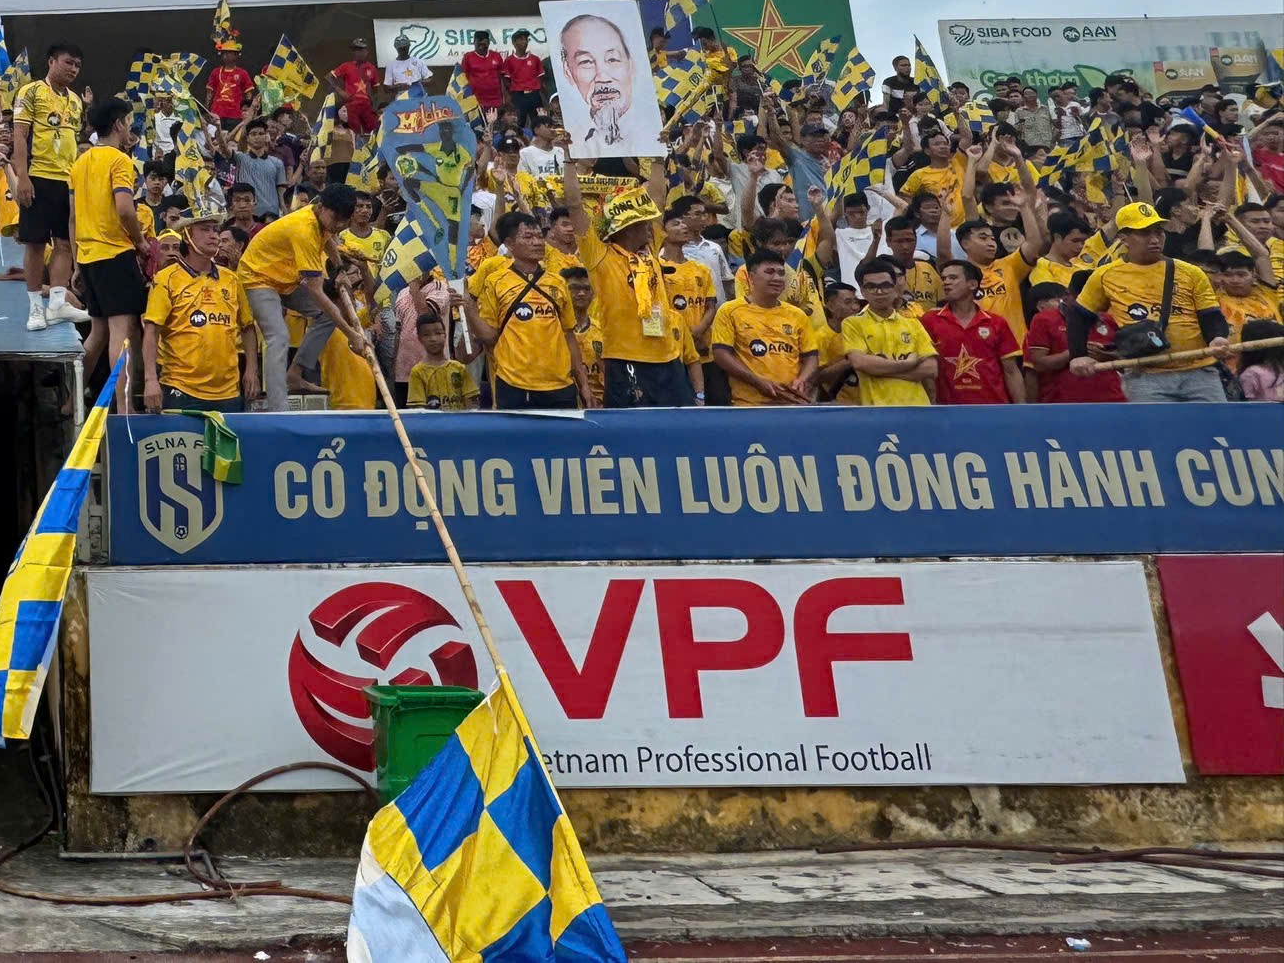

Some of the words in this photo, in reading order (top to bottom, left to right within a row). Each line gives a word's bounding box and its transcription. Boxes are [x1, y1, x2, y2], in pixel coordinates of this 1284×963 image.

[976, 27, 1009, 38] SIBA
[1012, 27, 1052, 38] FOOD
[1082, 25, 1117, 38] AAN
[144, 437, 187, 455] SLNA
[193, 439, 205, 449] F
[273, 437, 346, 519] CỔ
[363, 446, 517, 530] ĐỘNG
[531, 445, 662, 515] VIÊN
[676, 443, 824, 514] LUÔN
[837, 433, 995, 512] ĐỒNG
[1004, 438, 1166, 508] HÀNH
[495, 577, 913, 720] VPF
[542, 749, 629, 774] etnam
[637, 743, 808, 773] Professional
[815, 742, 933, 772] Football
